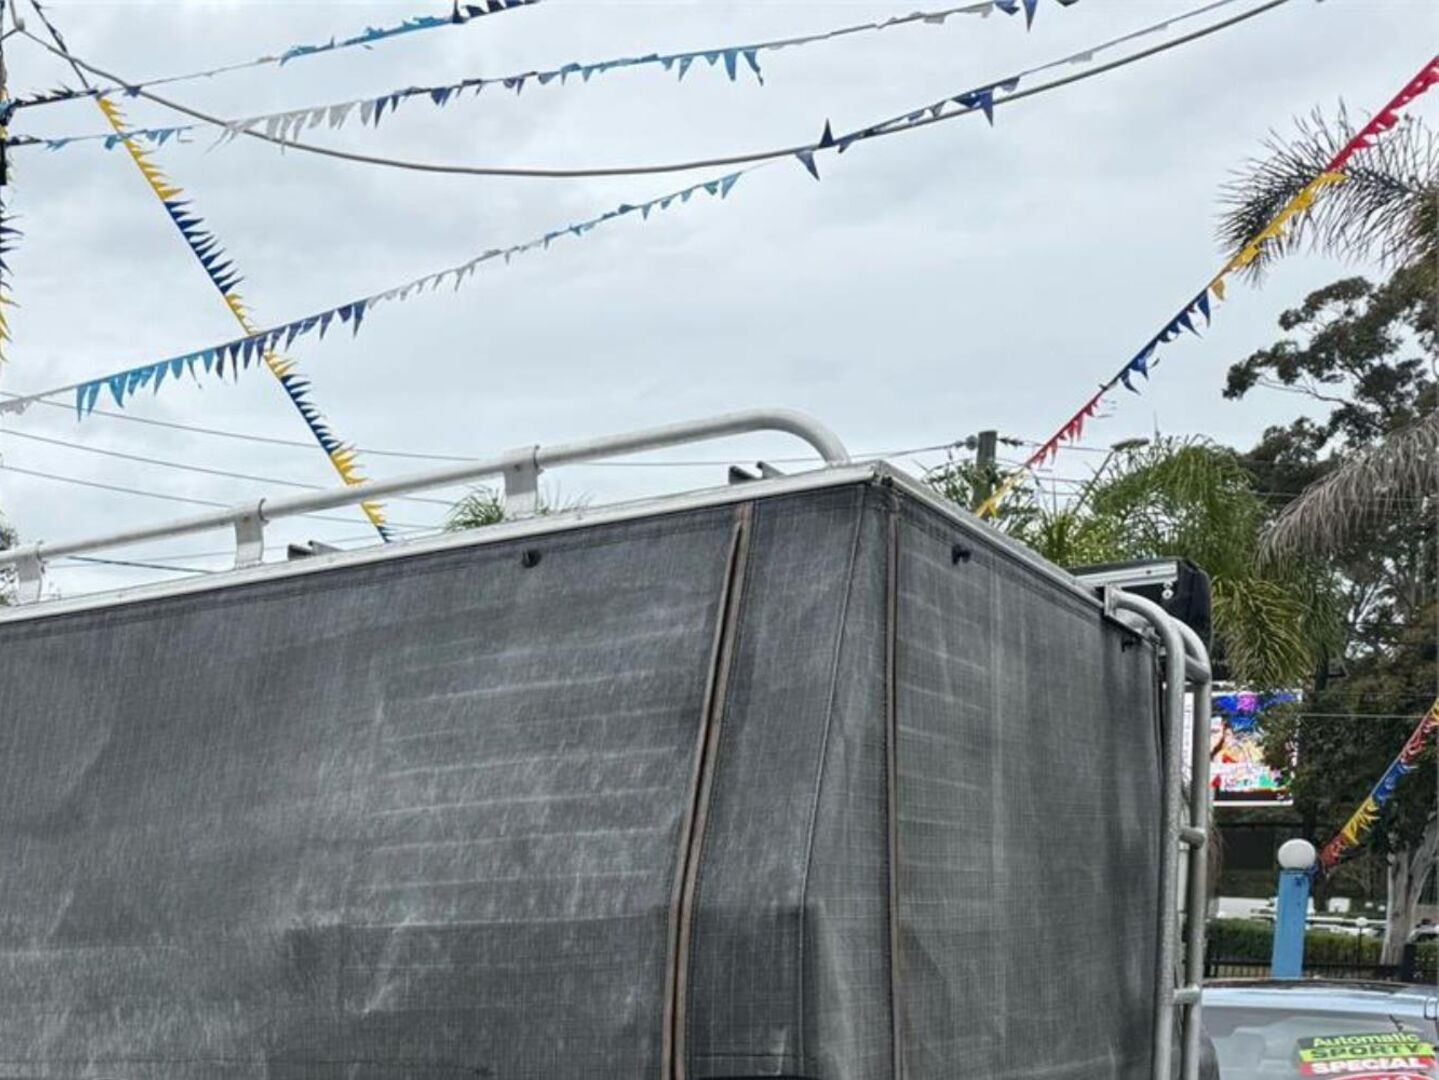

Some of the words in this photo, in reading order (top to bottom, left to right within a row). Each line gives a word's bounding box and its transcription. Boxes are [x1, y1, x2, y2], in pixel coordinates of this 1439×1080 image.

[1313, 1032, 1421, 1047] Automatic
[1310, 1044, 1419, 1059] SPORTY
[1310, 1057, 1429, 1075] SPECIAL
